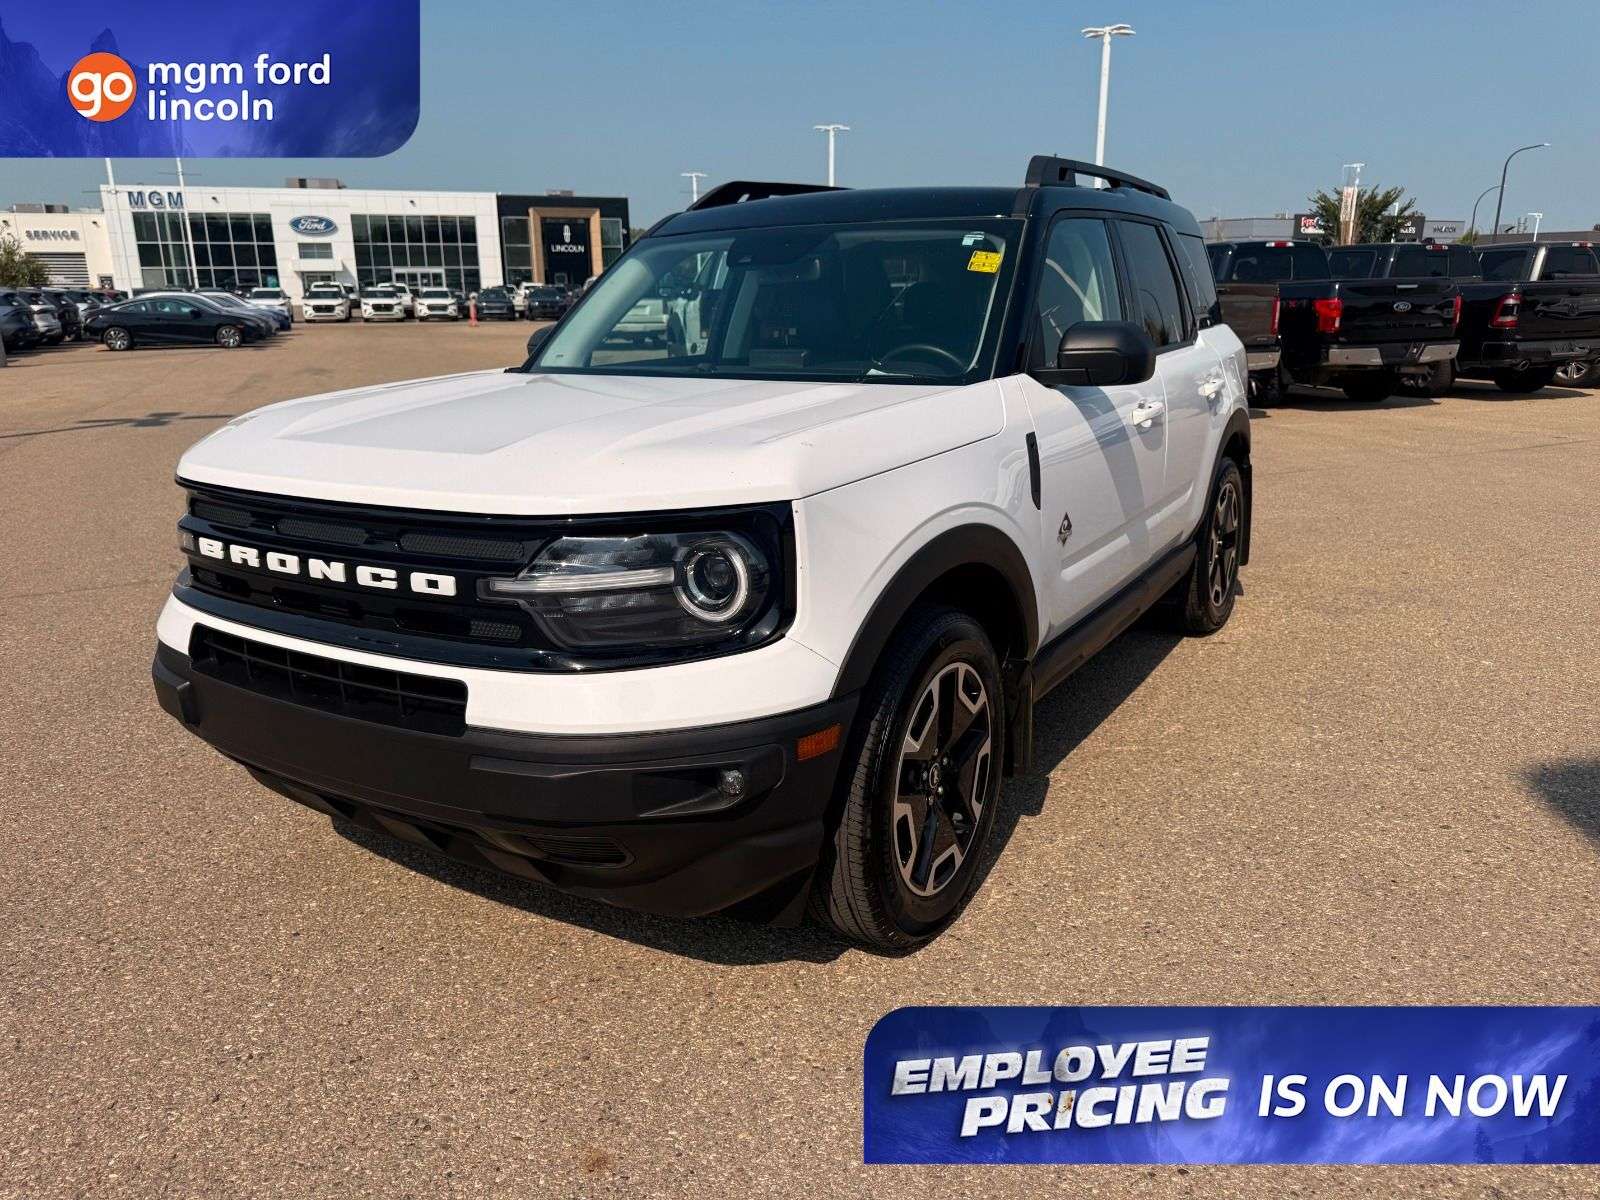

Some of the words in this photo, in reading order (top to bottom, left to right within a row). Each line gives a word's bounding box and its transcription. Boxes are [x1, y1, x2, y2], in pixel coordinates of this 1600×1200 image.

[128, 191, 184, 208] MGM
[298, 218, 326, 230] Ford
[26, 230, 79, 240] SERVICE
[551, 244, 585, 253] LINCOLN
[197, 535, 457, 597] BRONCO
